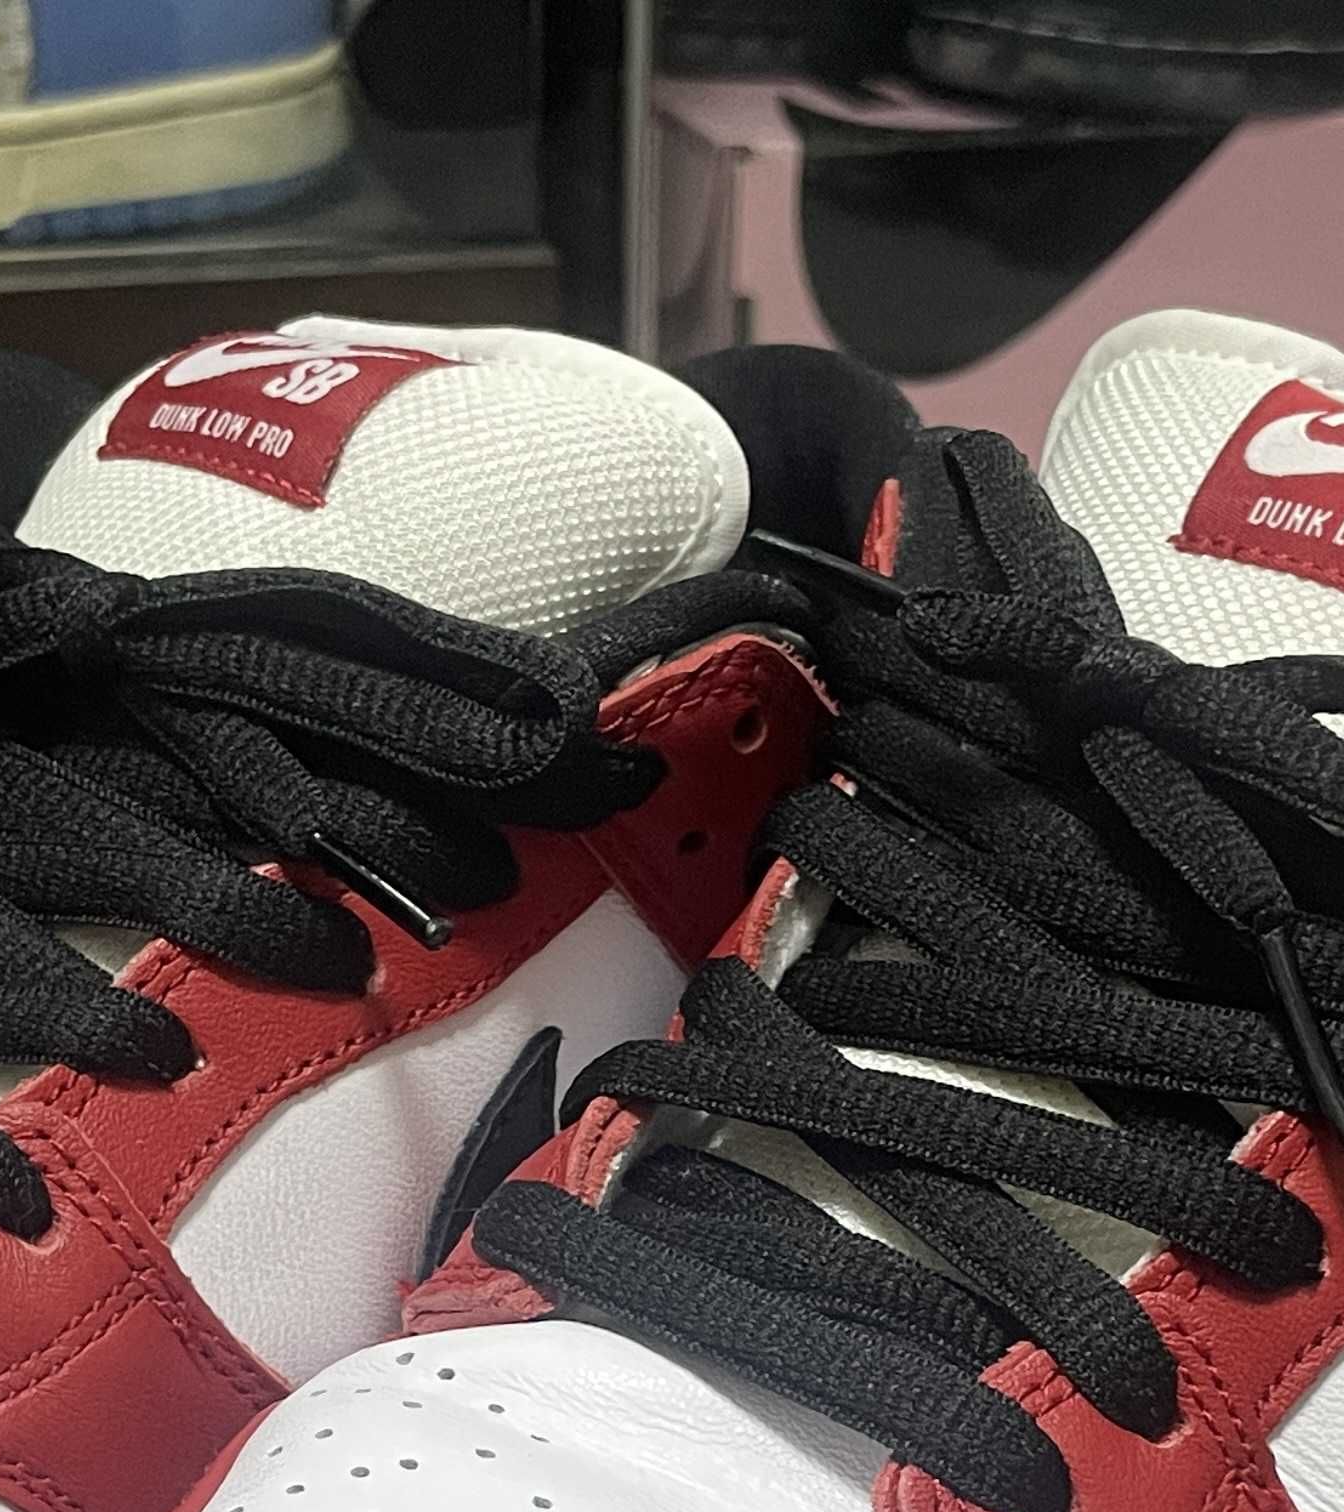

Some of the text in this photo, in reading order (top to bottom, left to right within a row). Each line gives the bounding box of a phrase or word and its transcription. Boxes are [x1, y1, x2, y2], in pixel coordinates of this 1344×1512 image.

[261, 359, 360, 405] SB
[150, 403, 294, 459] DUNK LOW PRO
[1247, 496, 1332, 539] DUNK
